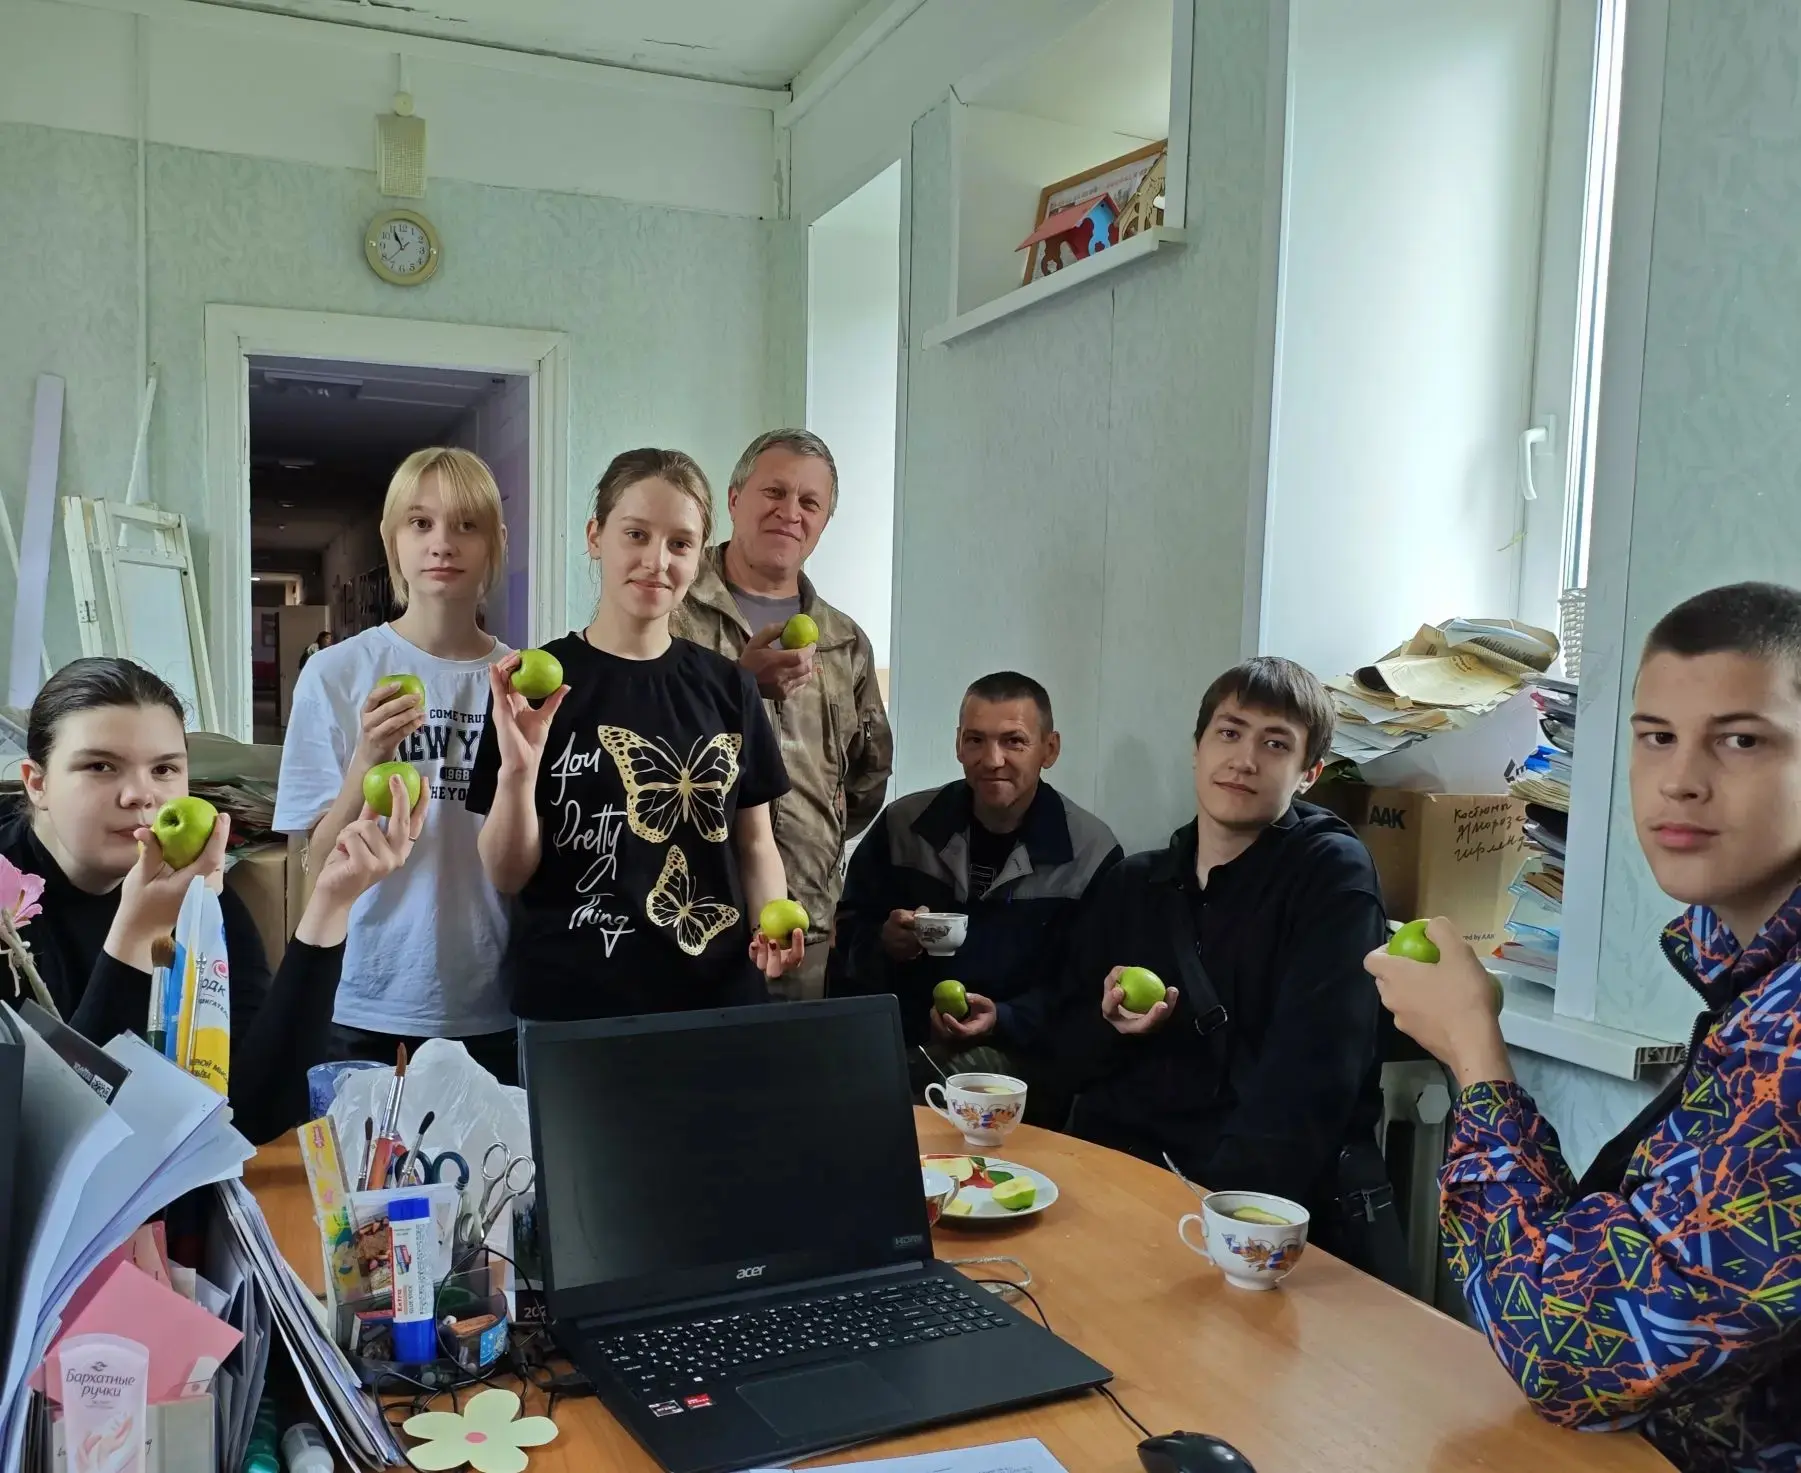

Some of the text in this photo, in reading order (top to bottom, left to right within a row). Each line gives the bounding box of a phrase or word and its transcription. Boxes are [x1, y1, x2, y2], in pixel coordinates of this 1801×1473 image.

[382, 231, 391, 240] 10
[398, 224, 408, 232] 12
[429, 709, 486, 724] COME TRU
[429, 786, 446, 799] HE
[1369, 805, 1407, 830] AAK
[553, 800, 627, 893] Pretty
[736, 1265, 766, 1280] acer
[65, 1367, 136, 1386] Бархатные
[81, 1385, 122, 1399] ручки
